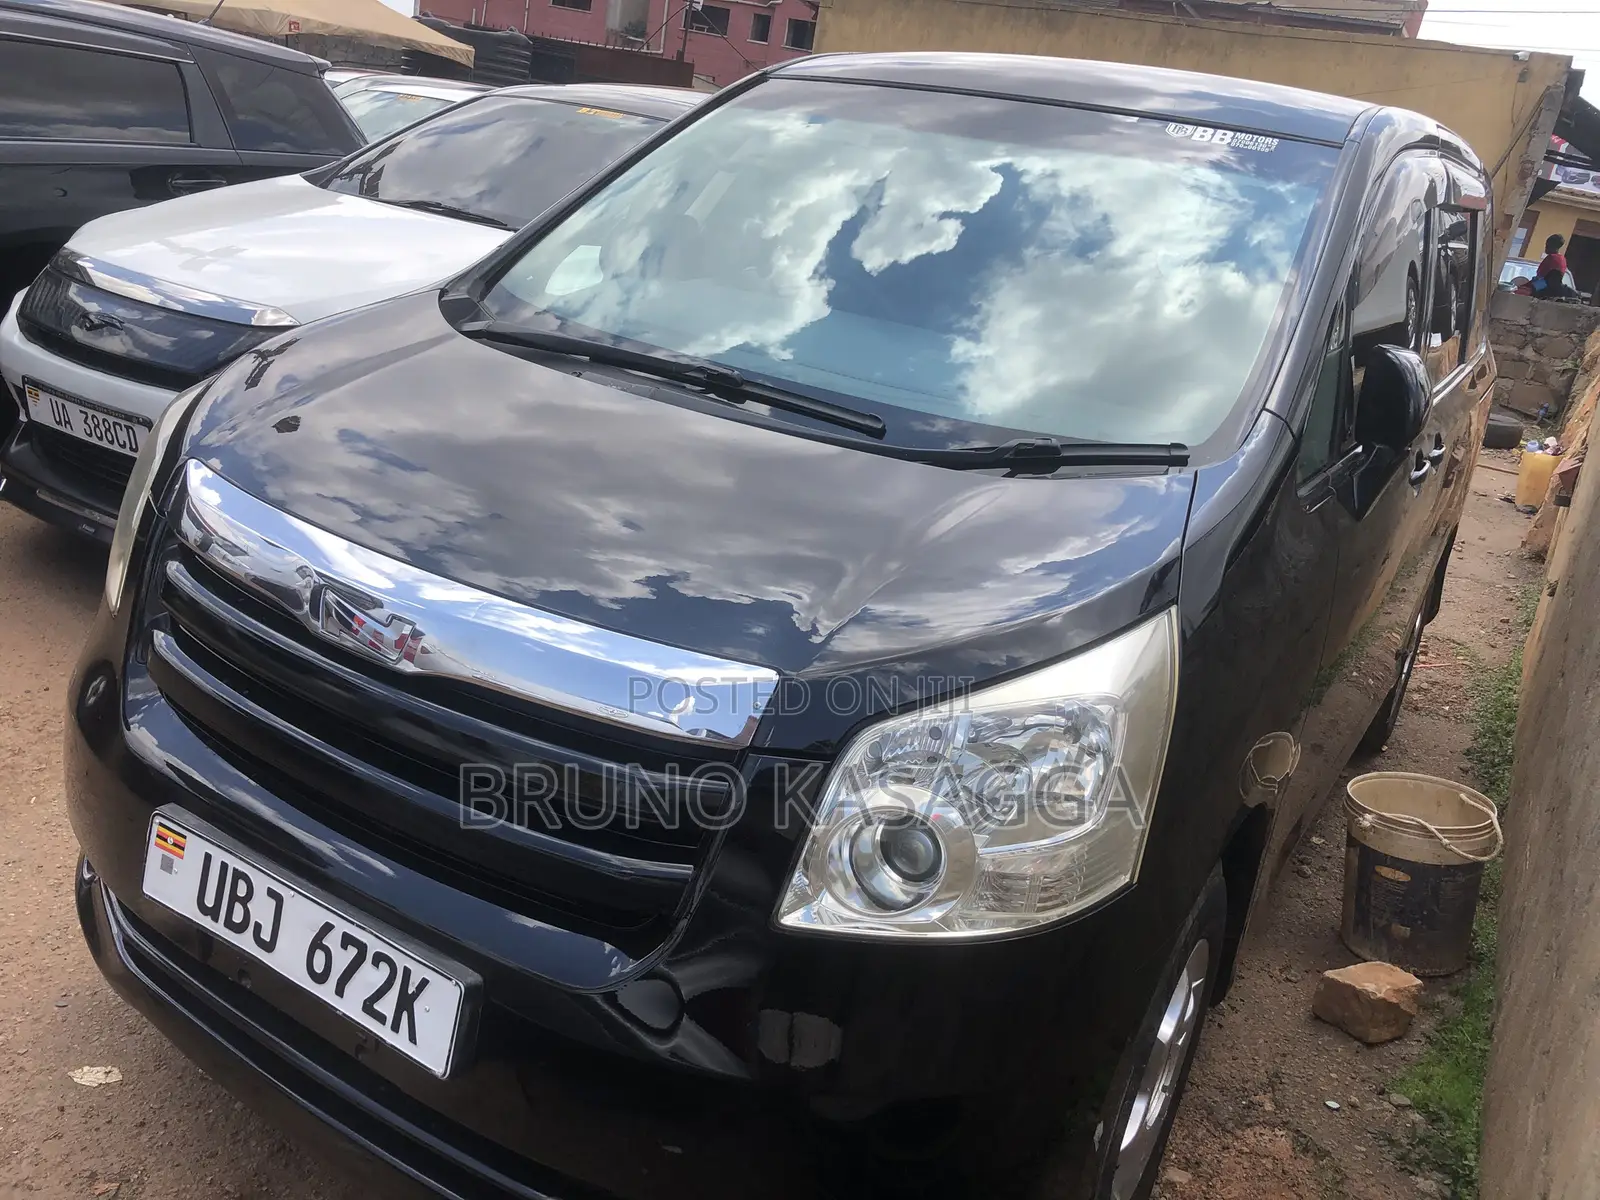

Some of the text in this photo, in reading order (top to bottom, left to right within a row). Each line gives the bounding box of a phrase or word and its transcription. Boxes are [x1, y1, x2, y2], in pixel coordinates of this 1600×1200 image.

[1191, 126, 1235, 145] BB
[1234, 132, 1280, 147] MOTORS
[48, 397, 75, 432] UA
[78, 408, 140, 454] 388CD
[196, 851, 431, 1046] UBJ 672K
